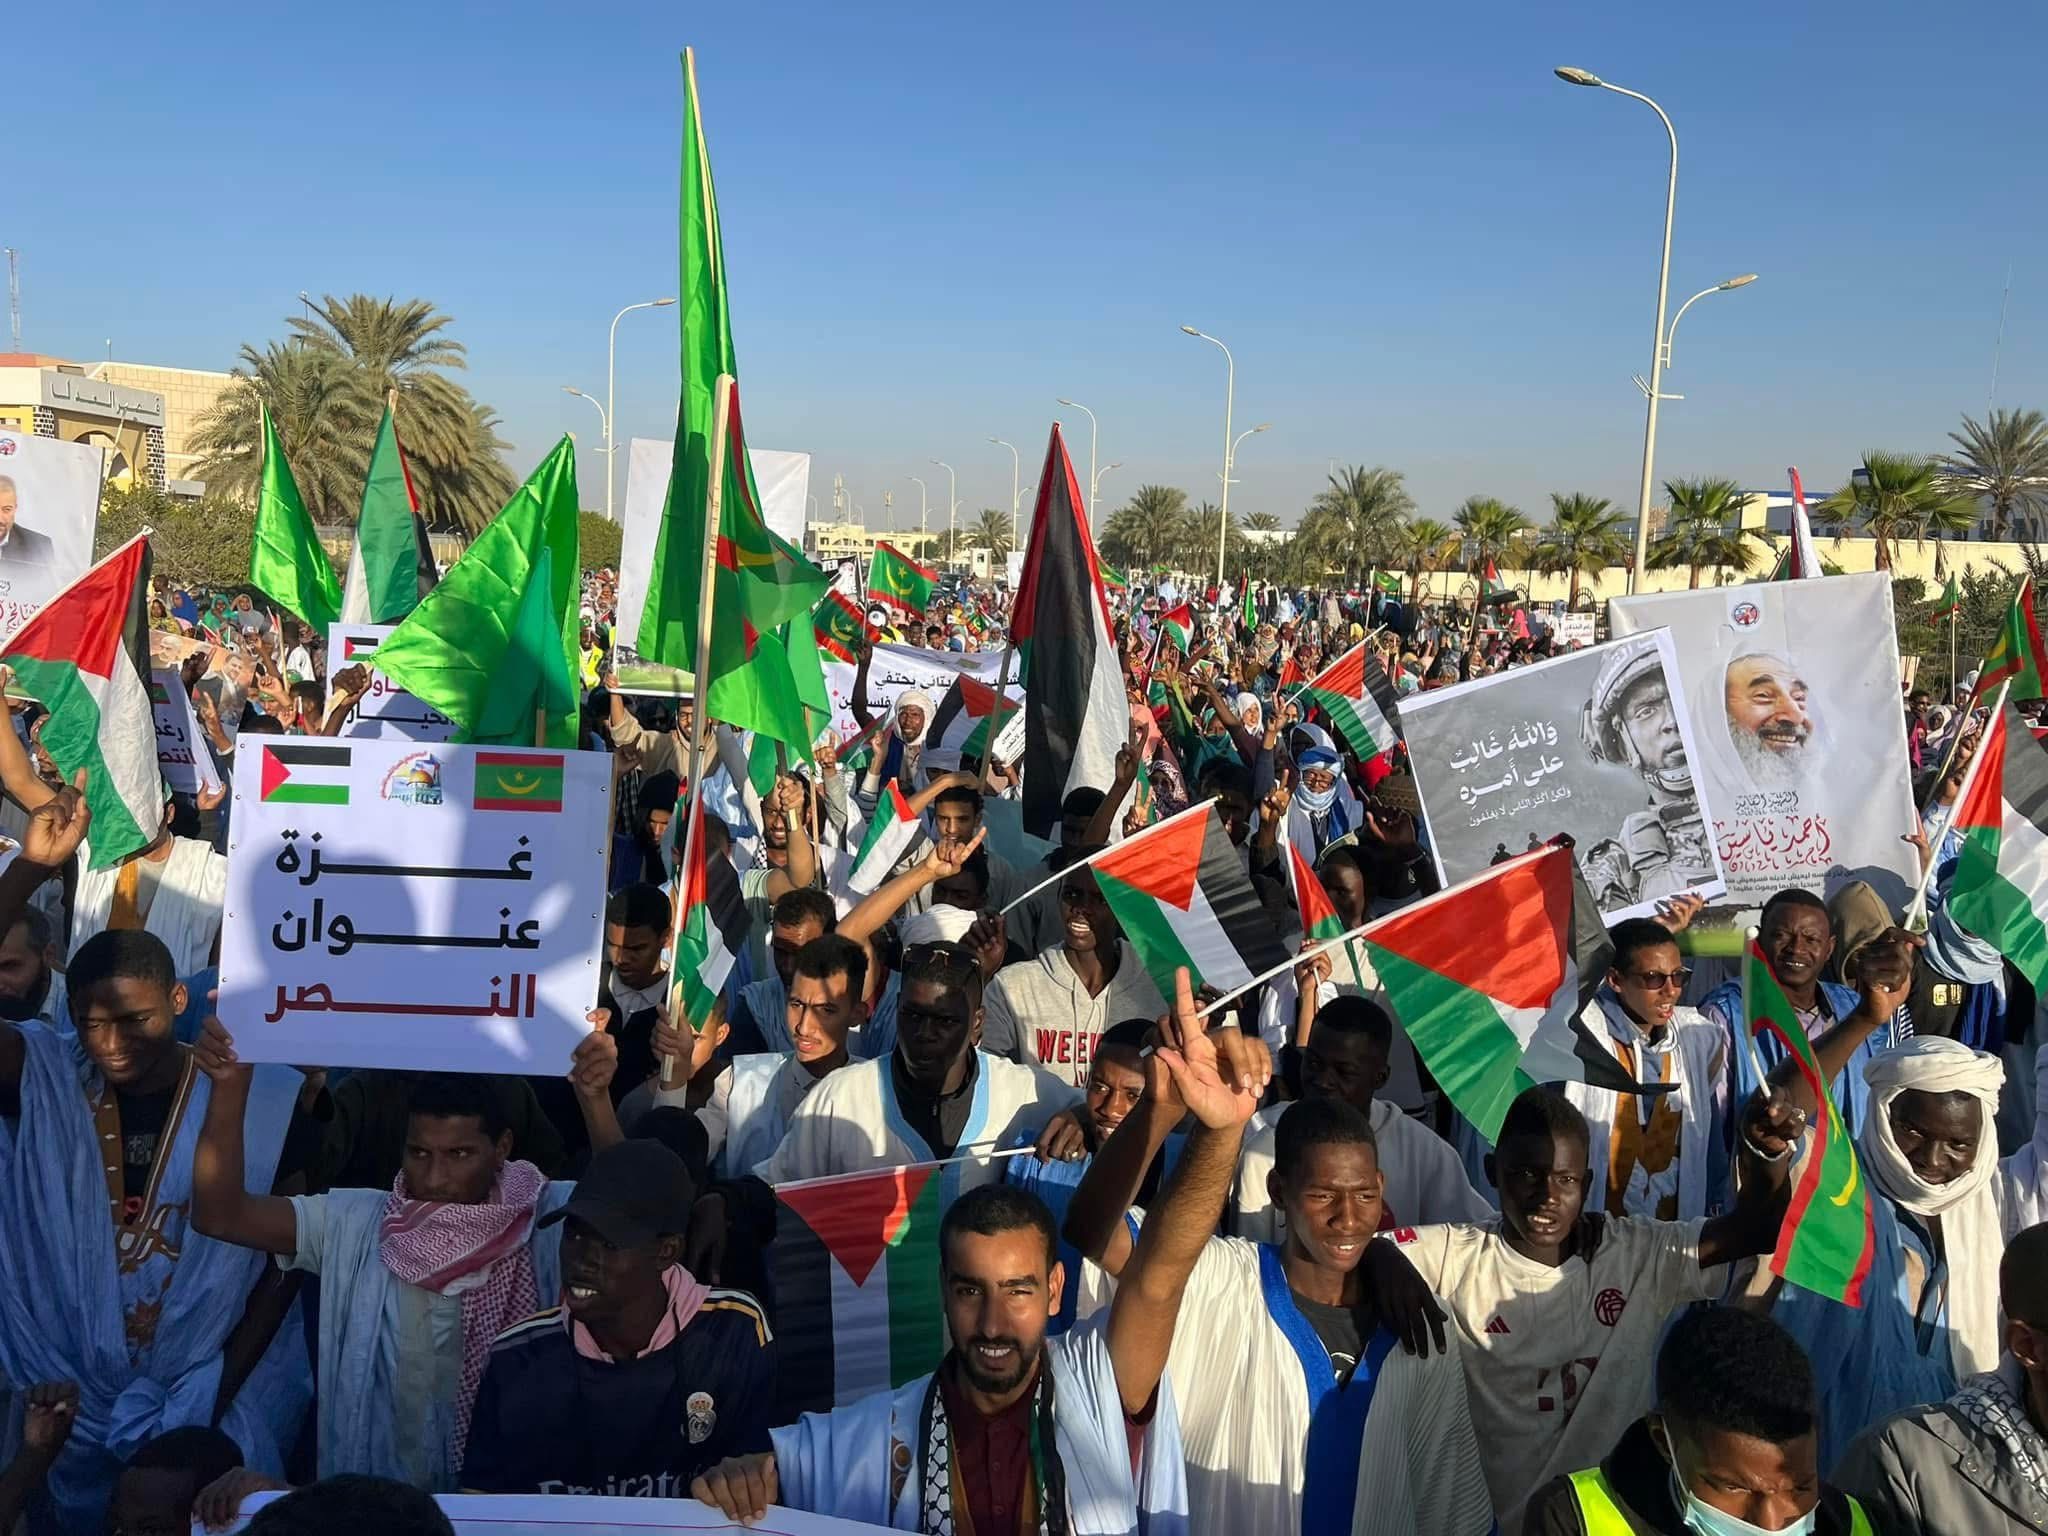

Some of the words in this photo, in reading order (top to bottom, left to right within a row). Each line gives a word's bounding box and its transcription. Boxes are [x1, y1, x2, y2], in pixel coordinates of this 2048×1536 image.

[50, 378, 115, 408] العدل
[875, 671, 916, 690] يحتفي
[839, 696, 891, 710] فلسين
[276, 829, 533, 886] غزة
[272, 898, 541, 956] عنوان
[265, 973, 536, 1024] النصر
